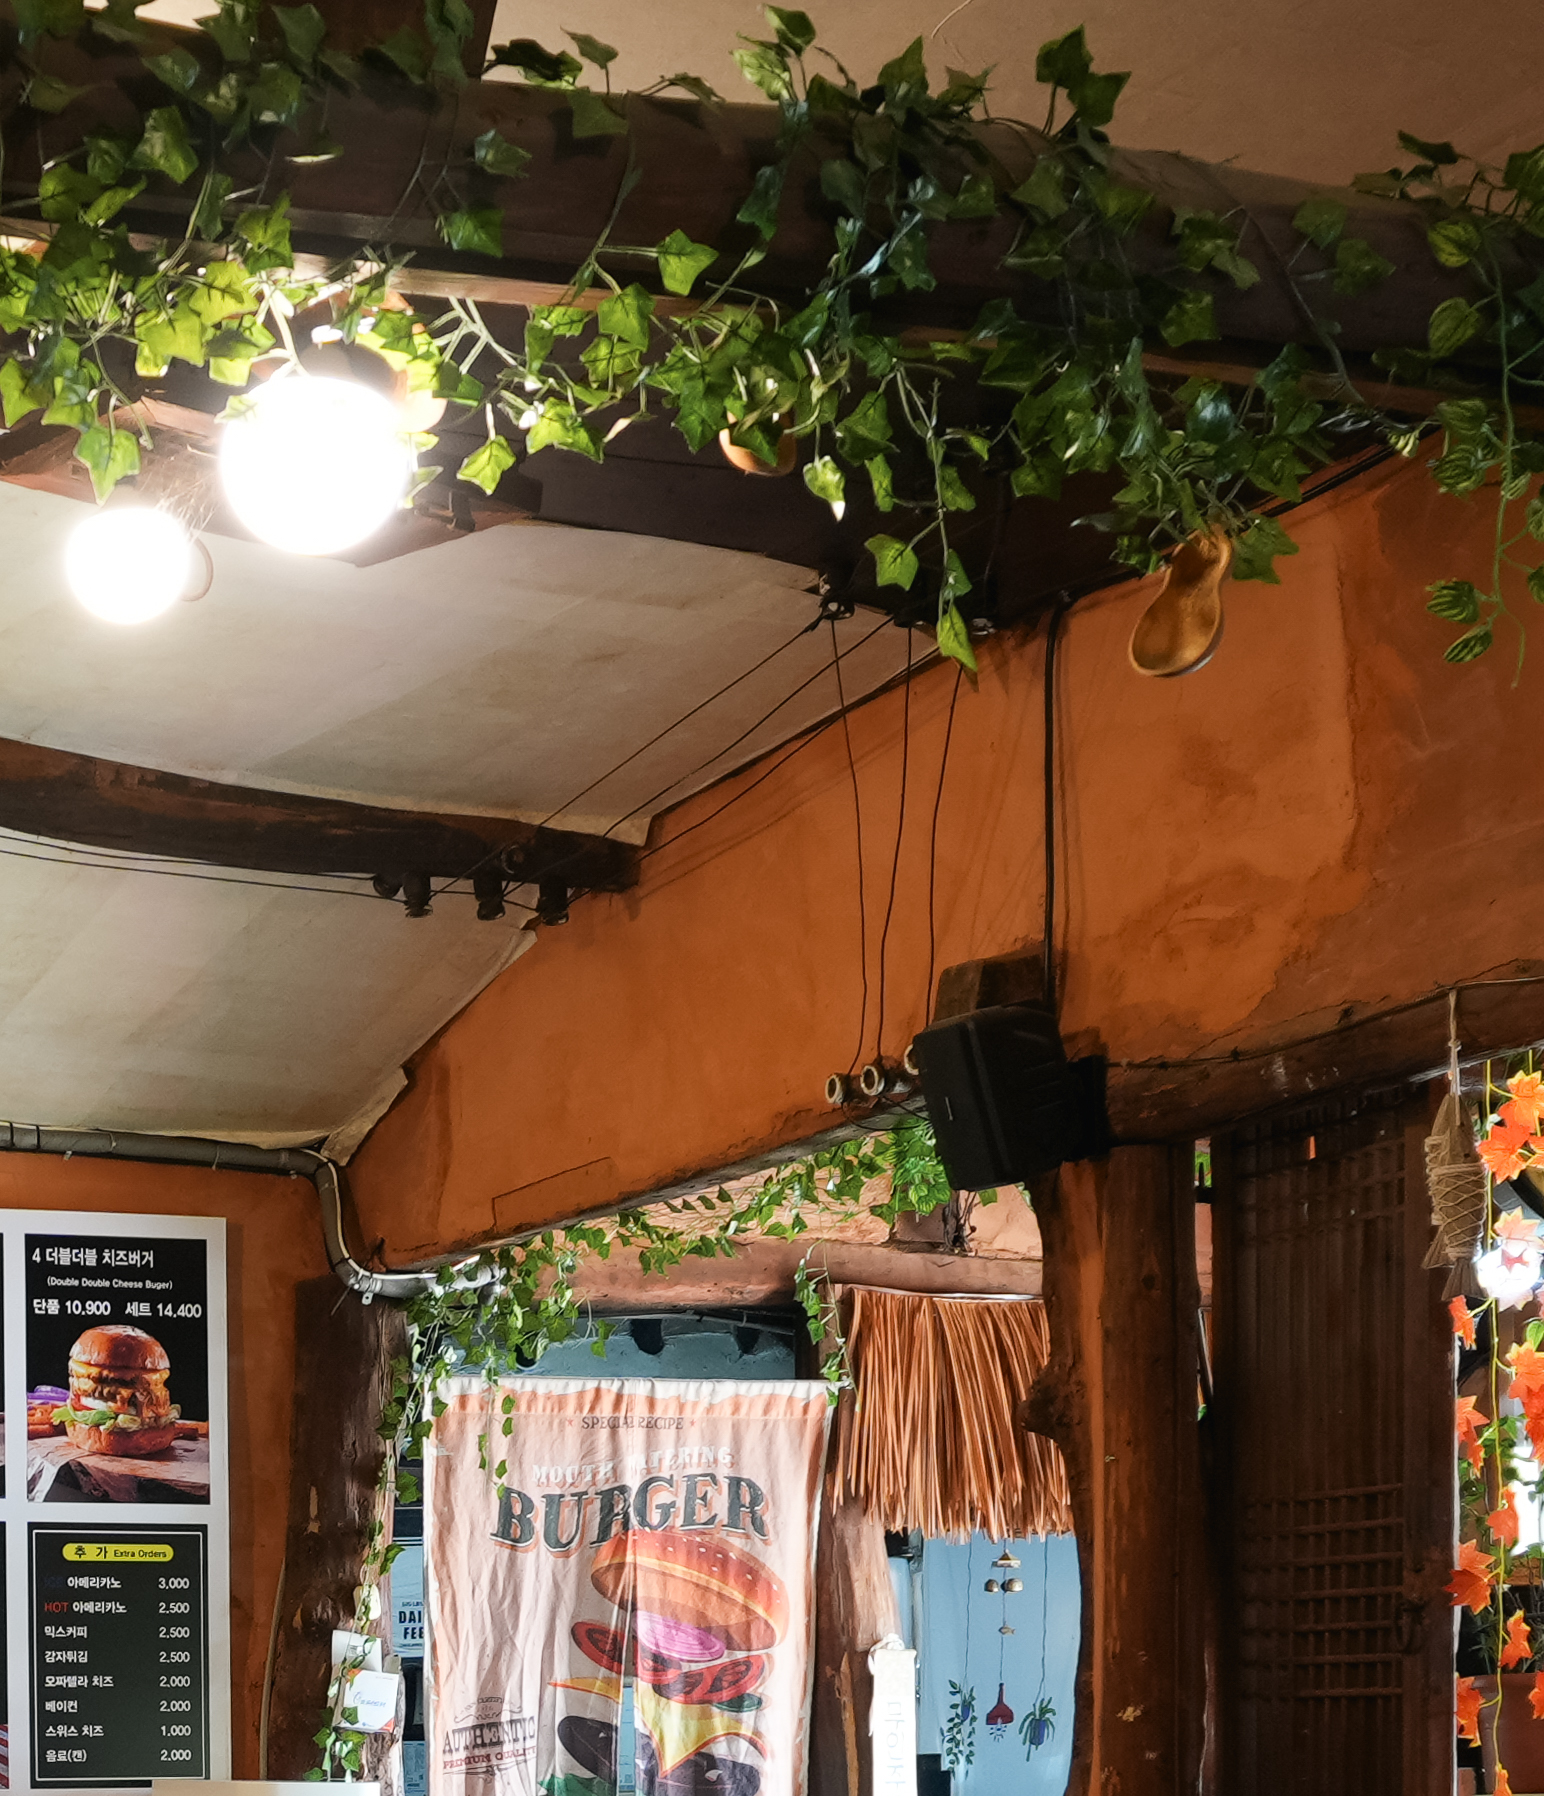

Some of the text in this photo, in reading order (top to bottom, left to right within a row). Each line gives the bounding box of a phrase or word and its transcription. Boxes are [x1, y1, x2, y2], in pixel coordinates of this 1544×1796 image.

[32, 1247, 153, 1268] 4 더블더블 치즈버거
[47, 1276, 172, 1290] (Double Double Cheese Buger)
[33, 1299, 201, 1318] 단품 10.900 세트 14.400
[581, 1415, 684, 1430] SPECIAL RECIPE
[489, 1471, 770, 1553] BURGER
[113, 1549, 136, 1558] Extra
[138, 1549, 167, 1558] Orders
[67, 1577, 121, 1588] 아메리카노
[44, 1602, 69, 1613] HOT
[73, 1601, 127, 1613] 아메리카노
[45, 1626, 87, 1638] 믹스커피
[403, 1626, 424, 1640] FEE
[45, 1651, 87, 1663] 감자튀김
[92, 1676, 113, 1687] 치즈
[160, 1676, 190, 1687] 2.000
[46, 1700, 191, 1712] 베이컨 2.000
[46, 1725, 191, 1737] 스위스 치즈 1.000
[442, 1716, 536, 1754] AUTHENTIC
[161, 1749, 191, 1761] 2.000
[494, 1745, 537, 1761] QUALITY
